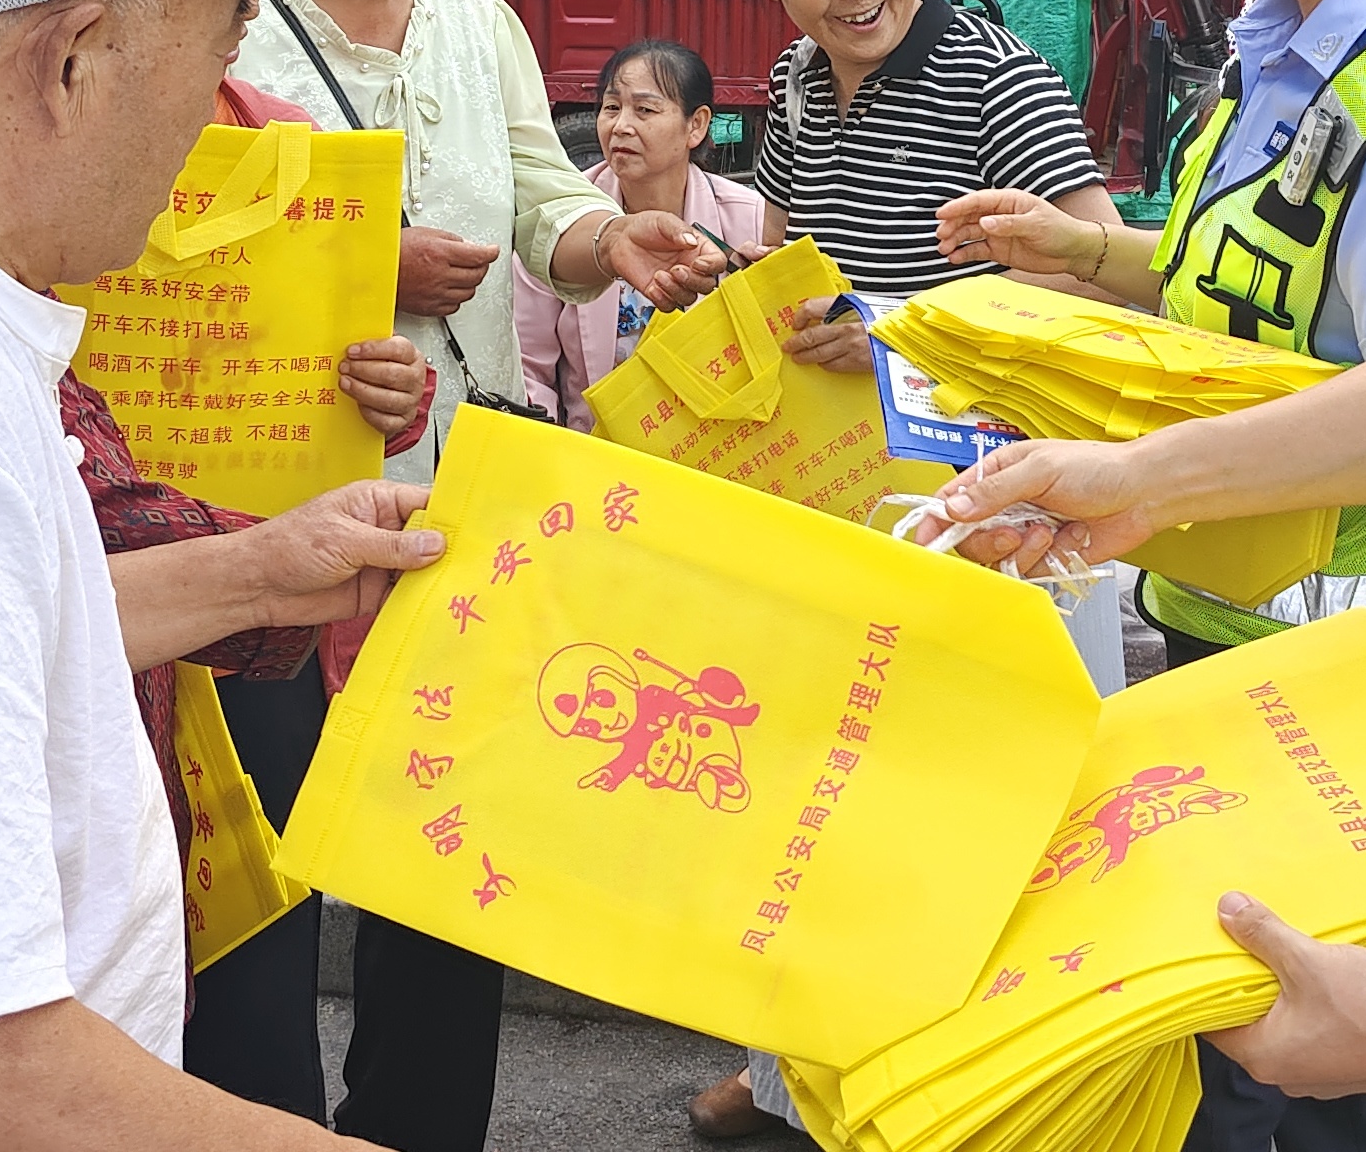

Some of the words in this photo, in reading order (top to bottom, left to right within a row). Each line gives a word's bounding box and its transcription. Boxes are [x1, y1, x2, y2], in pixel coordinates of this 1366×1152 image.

[91, 313, 251, 341] 开车不接打电话
[88, 352, 202, 375] 喝酒不开车
[221, 355, 333, 376] 开车不喝酒
[167, 426, 234, 445] 不超载
[246, 423, 312, 442] 不超速
[793, 419, 874, 480] 开车不喝酒
[739, 621, 902, 957] 凤县公安局交通管理大队
